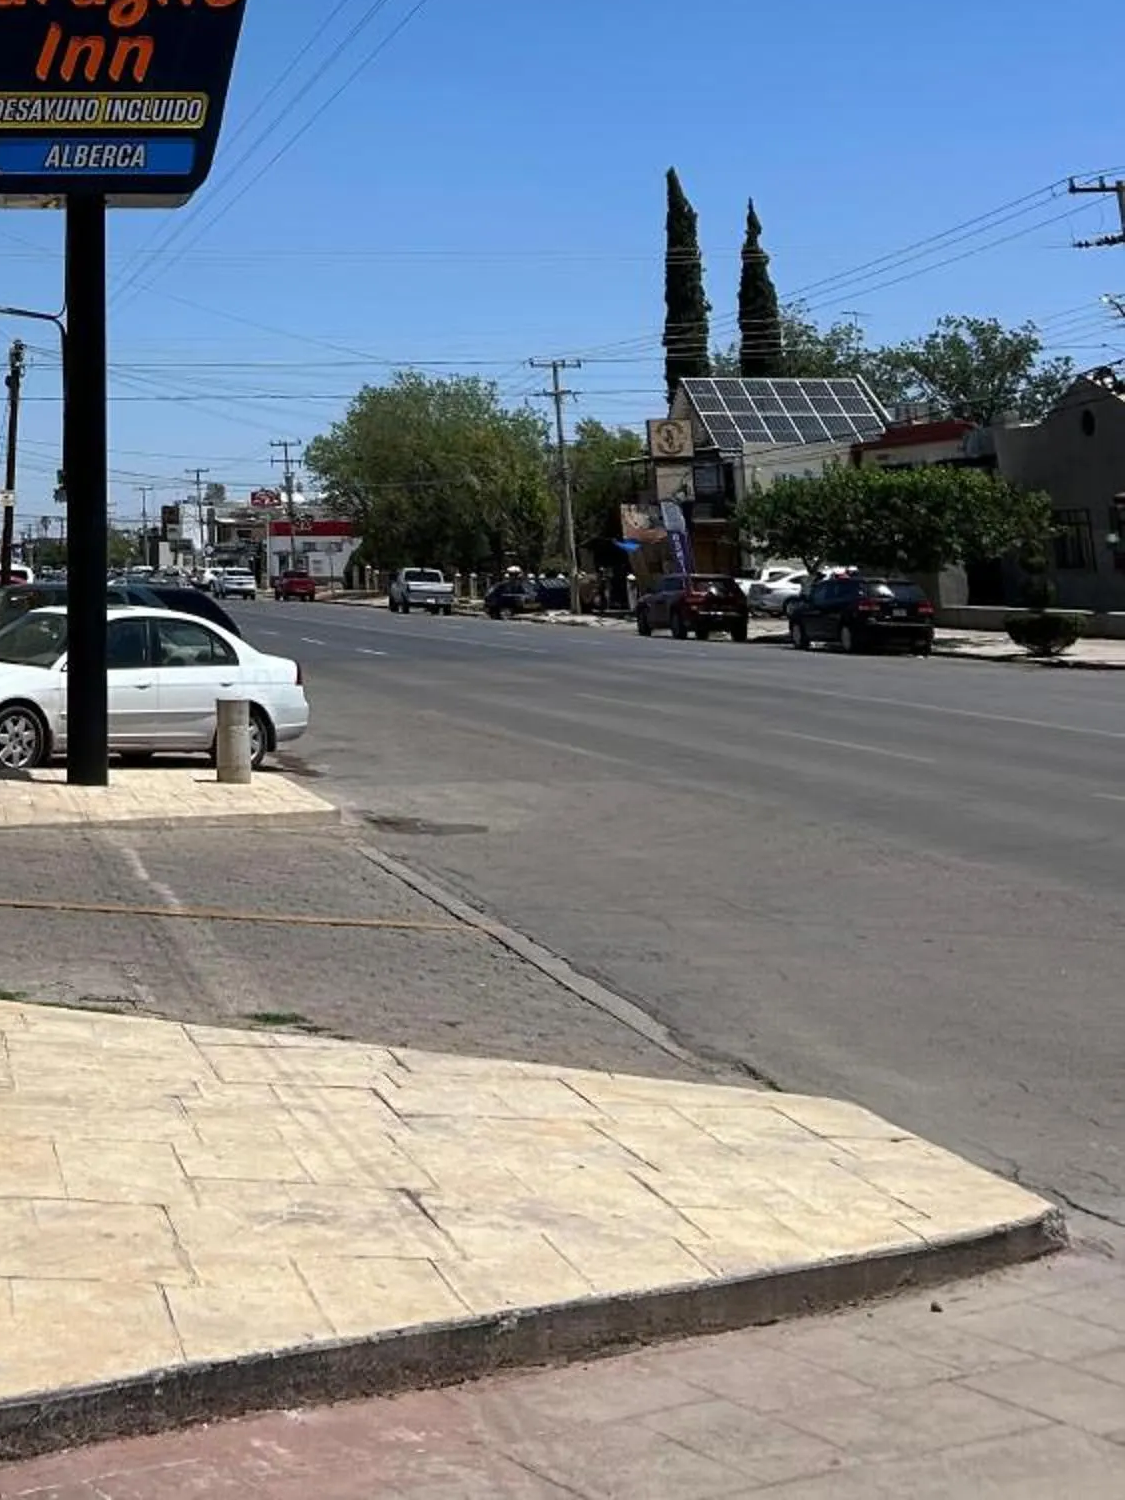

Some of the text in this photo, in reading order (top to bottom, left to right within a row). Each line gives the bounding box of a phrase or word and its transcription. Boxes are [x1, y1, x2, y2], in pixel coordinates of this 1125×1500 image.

[35, 21, 155, 83] Inn
[103, 98, 203, 122] INCLUIDO
[44, 144, 146, 169] ALBERCA
